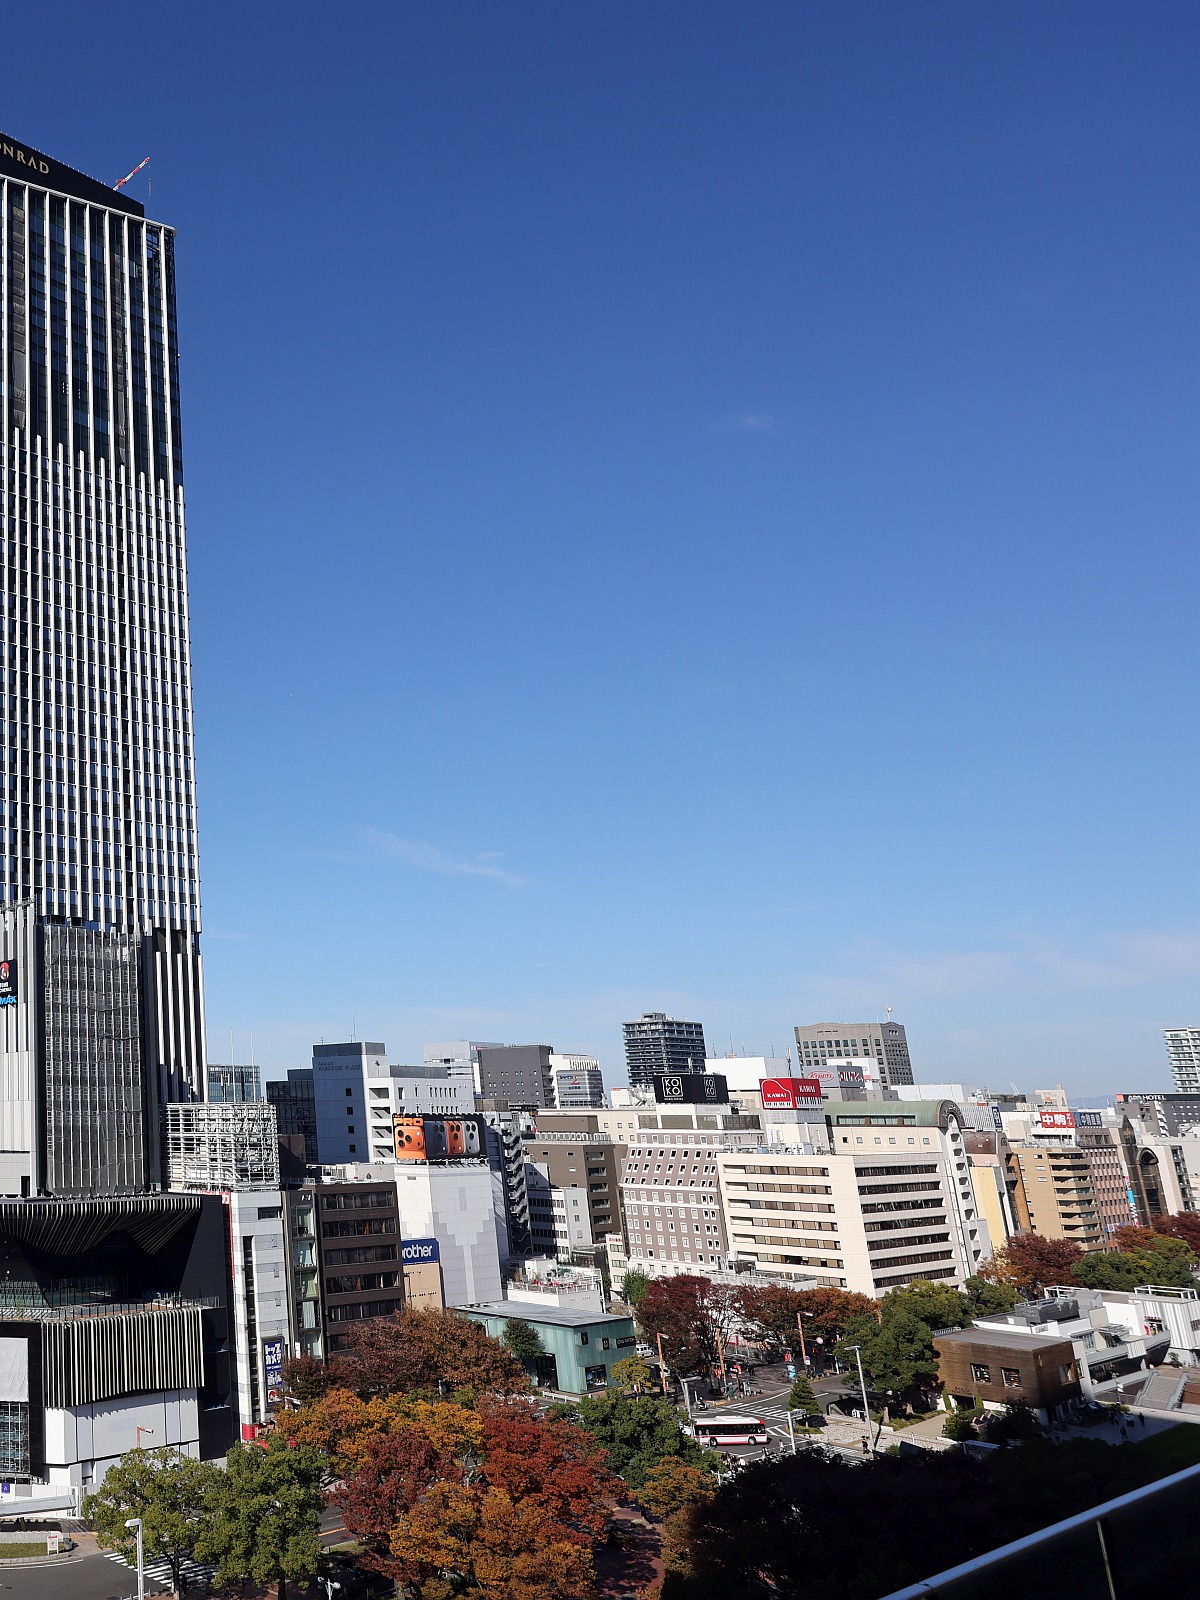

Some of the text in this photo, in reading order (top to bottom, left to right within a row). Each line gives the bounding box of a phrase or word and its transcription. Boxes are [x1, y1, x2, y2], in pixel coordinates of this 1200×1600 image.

[798, 1085, 816, 1093] KAWAI
[393, 1117, 424, 1126] PRO
[1041, 1113, 1067, 1126] 中駒
[402, 1244, 433, 1259] rother
